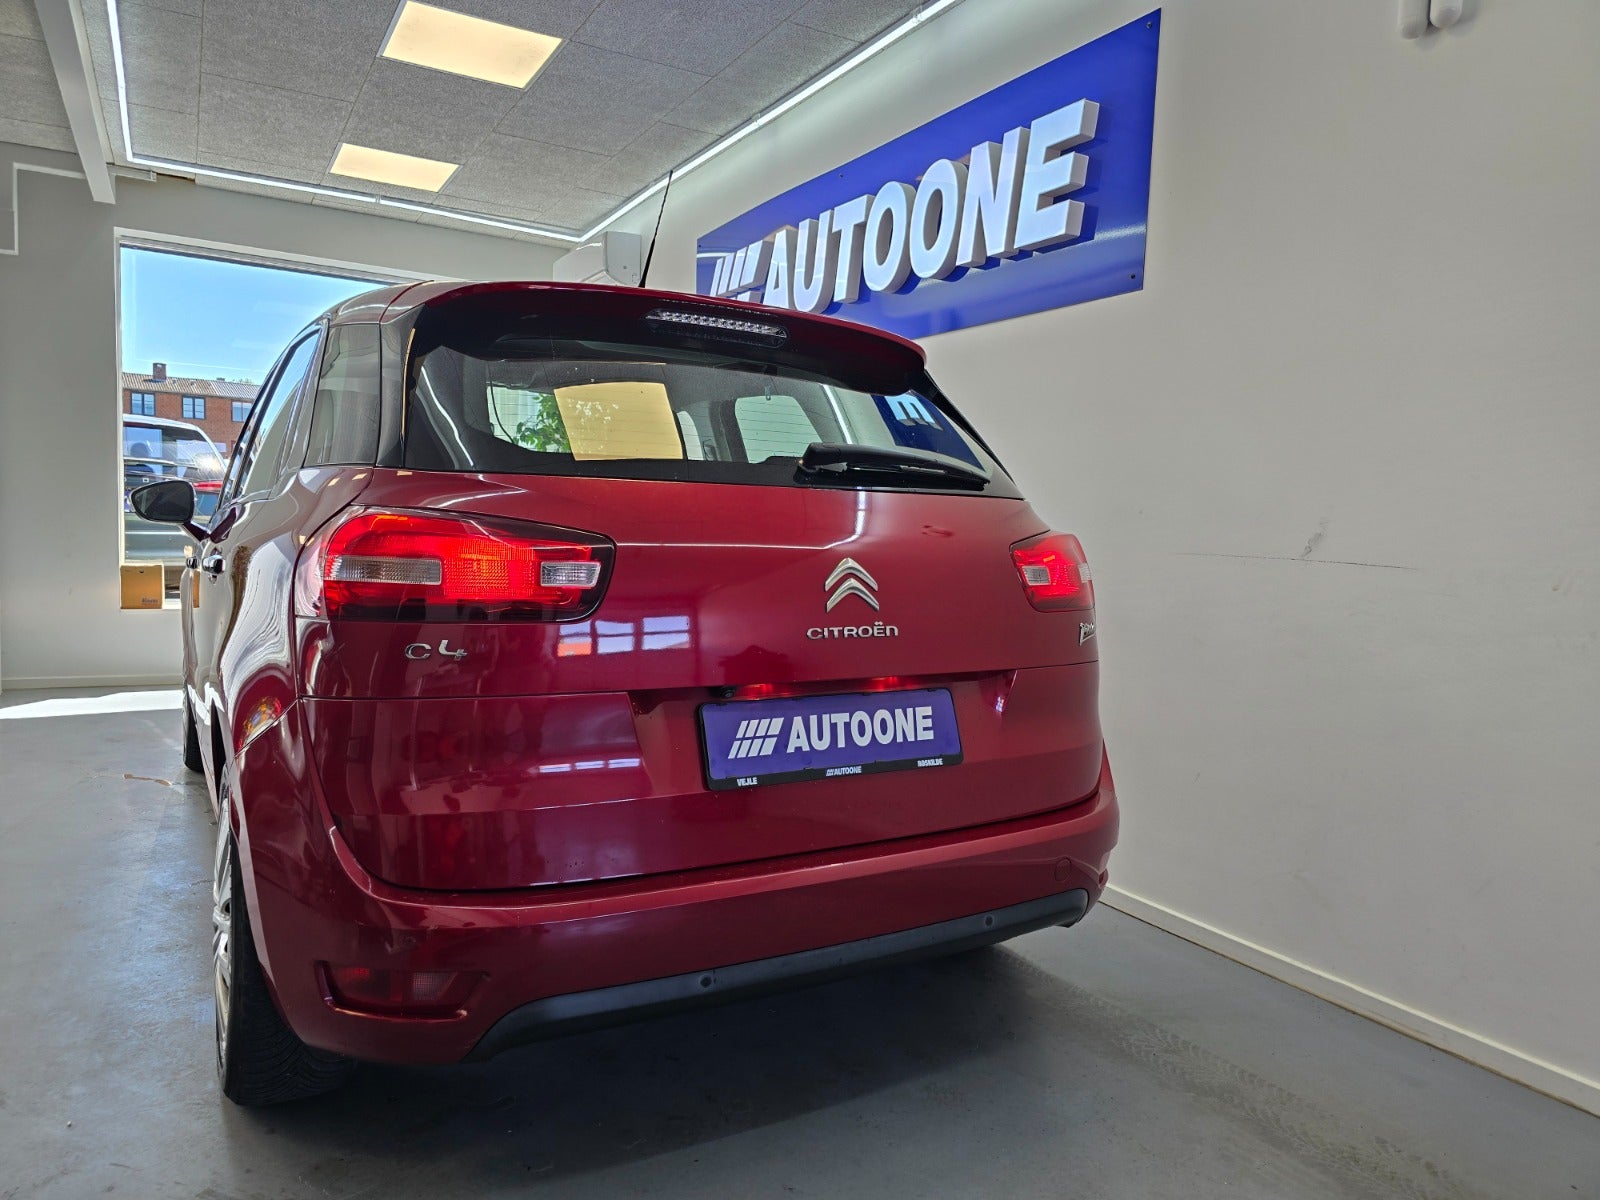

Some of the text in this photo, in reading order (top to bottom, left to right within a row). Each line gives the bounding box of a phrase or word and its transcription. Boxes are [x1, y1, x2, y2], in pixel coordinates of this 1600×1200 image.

[763, 98, 1100, 313] AUTOONE
[786, 706, 935, 754] AUTOONE
[736, 776, 758, 787] VEJLE
[833, 765, 862, 776] AUTOONE
